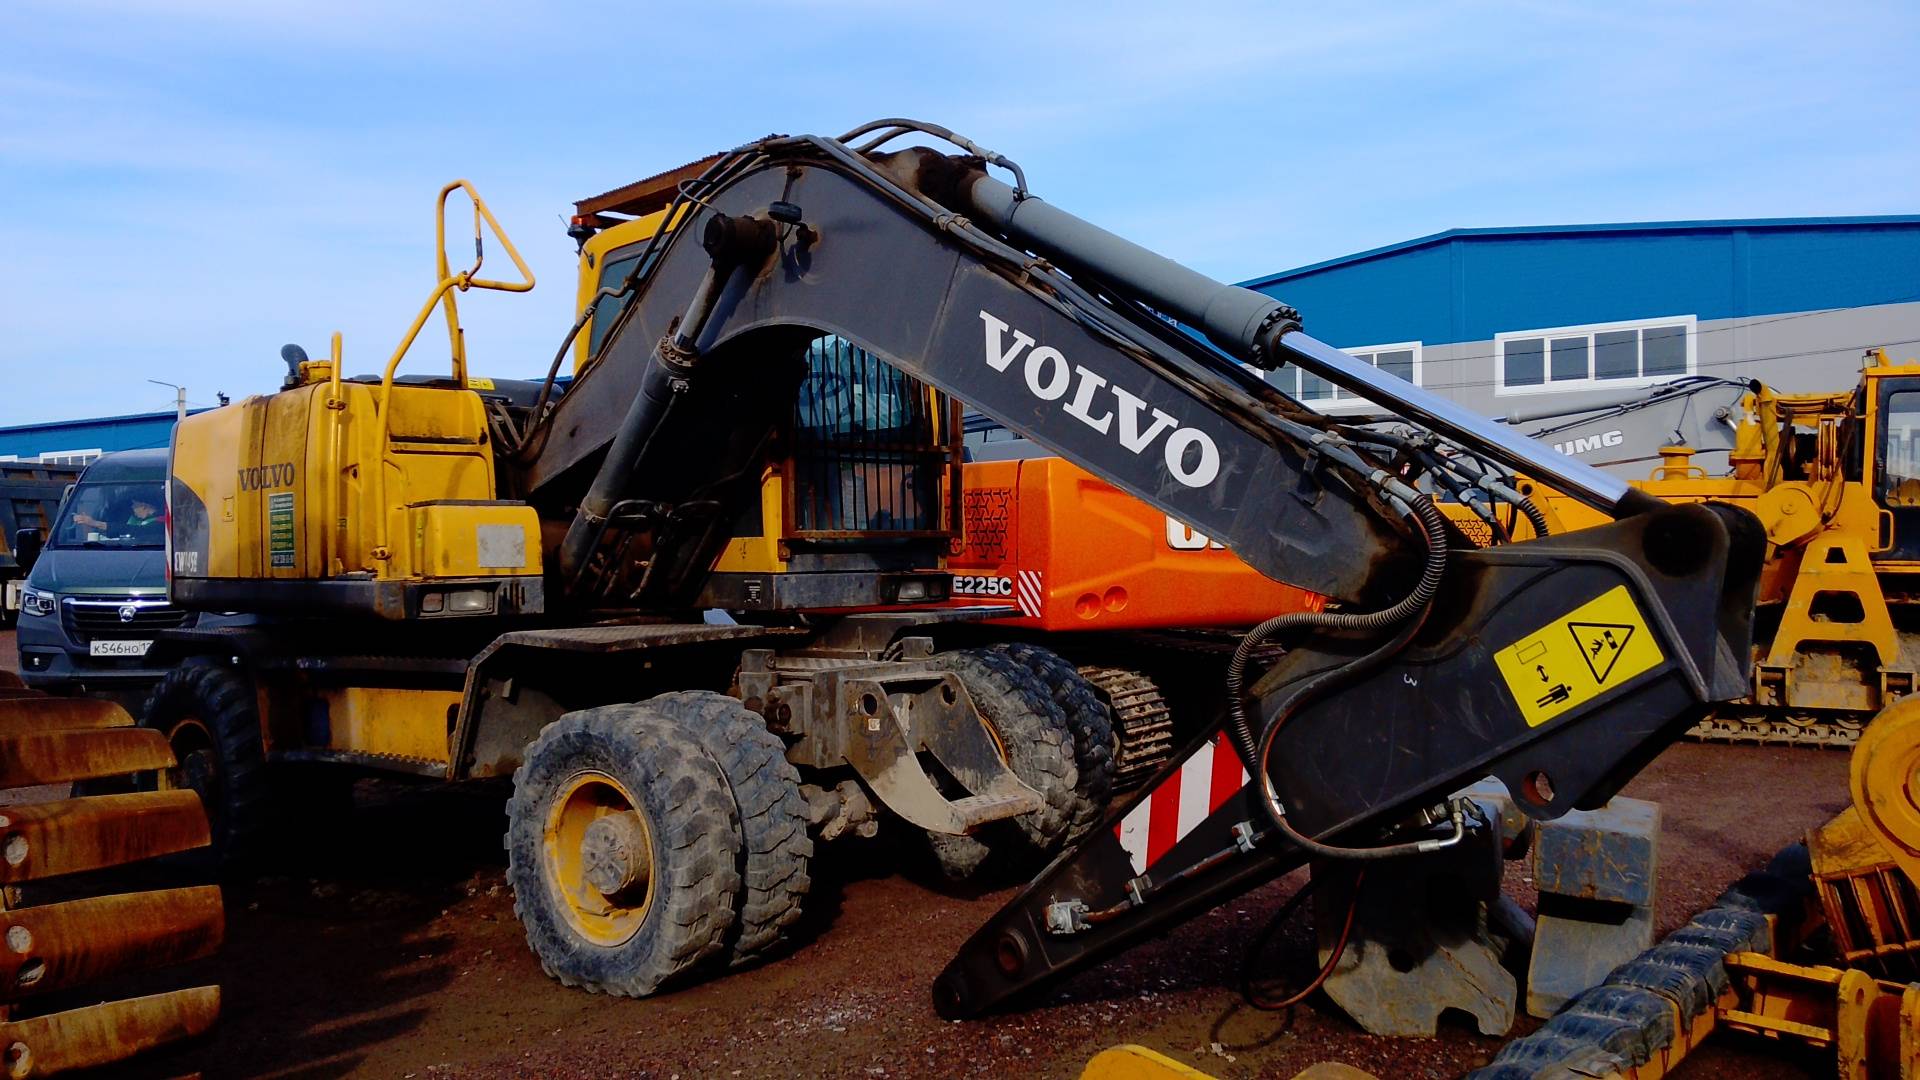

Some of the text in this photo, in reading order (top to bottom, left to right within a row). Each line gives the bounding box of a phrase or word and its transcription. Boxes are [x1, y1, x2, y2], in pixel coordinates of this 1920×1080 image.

[980, 310, 1220, 488] VOLVO
[1554, 431, 1623, 456] UMG
[238, 462, 295, 491] VOLVO
[953, 576, 1012, 595] E225C
